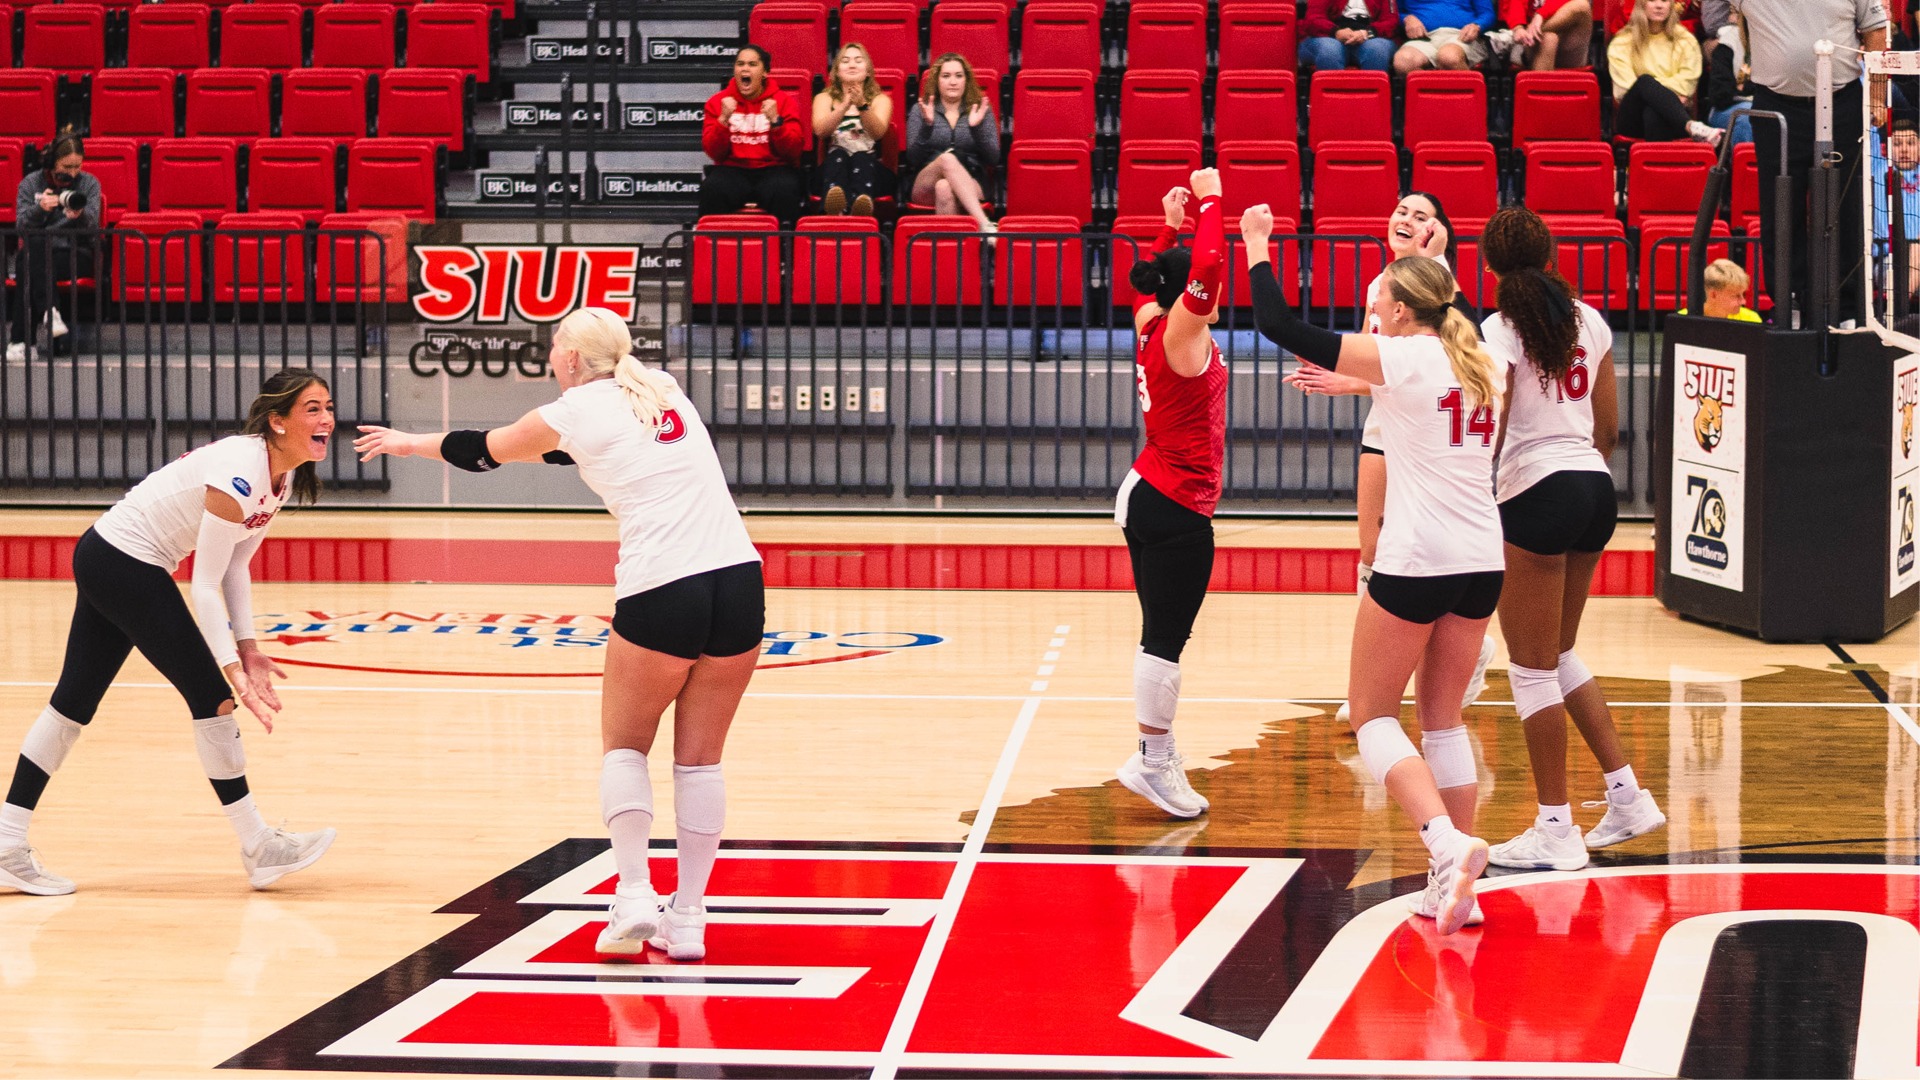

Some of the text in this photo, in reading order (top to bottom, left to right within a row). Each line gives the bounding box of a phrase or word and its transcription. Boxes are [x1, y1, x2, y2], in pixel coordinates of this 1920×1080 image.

[536, 46, 558, 58] BJC
[653, 45, 740, 57] BJC HealthCar
[513, 110, 535, 122] BJC
[631, 110, 706, 124] BJC HealthC
[487, 181, 510, 195] BJC
[608, 180, 700, 194] BJC HealthCare
[412, 246, 640, 323] SIUE
[408, 341, 555, 378] COUG
[1684, 360, 1735, 407] SIUE
[1438, 387, 1496, 447] 14
[1687, 540, 1727, 564] Hawthorne
